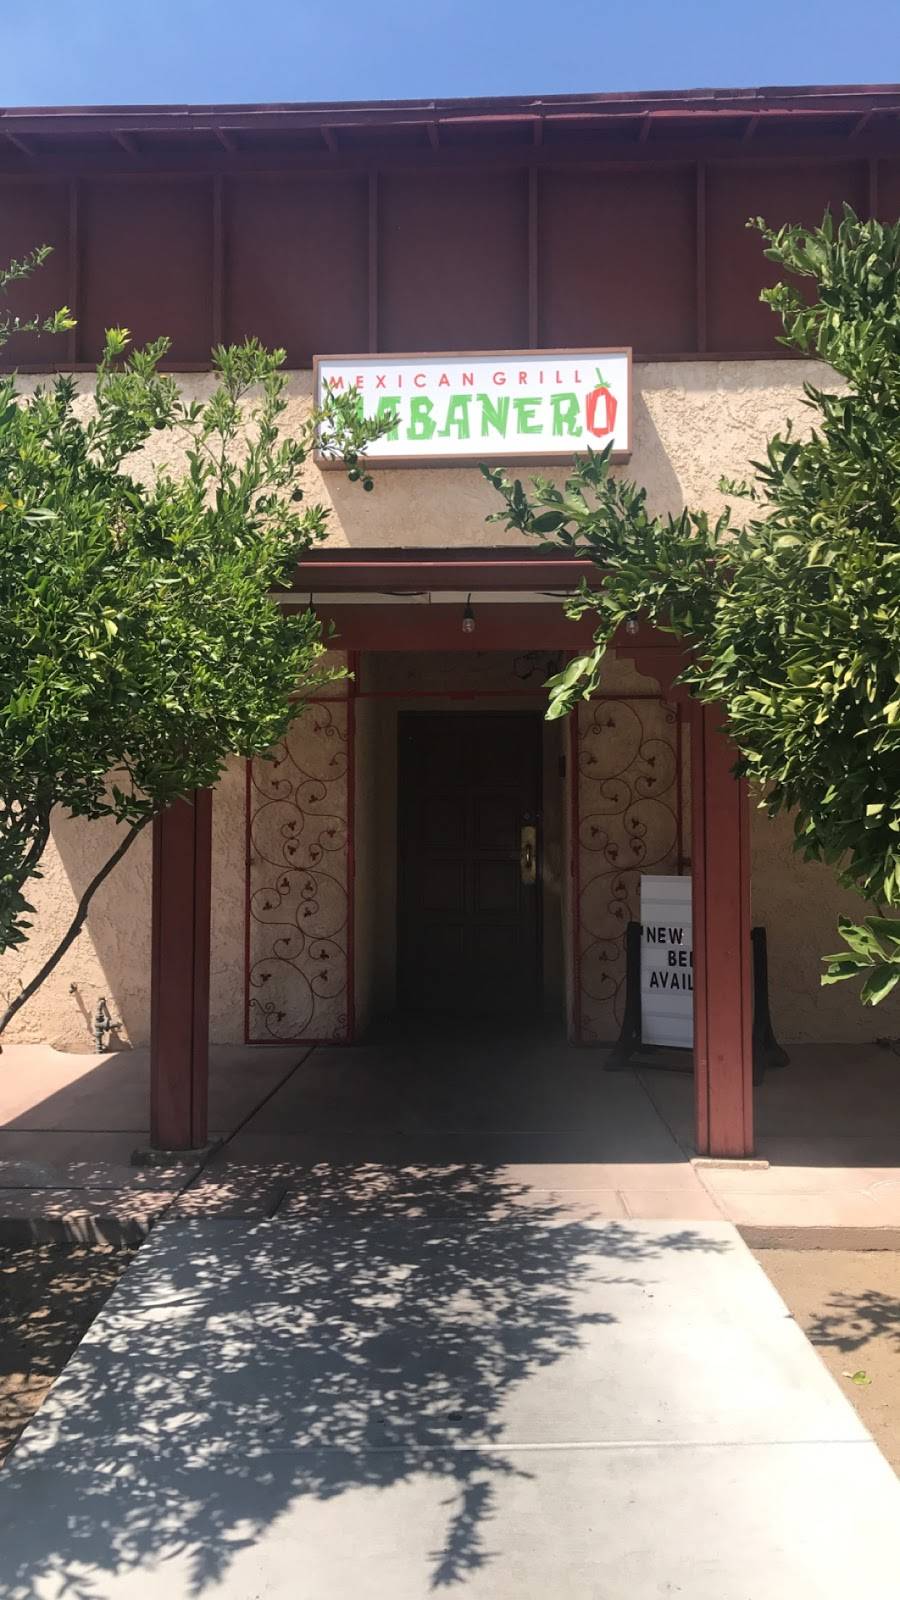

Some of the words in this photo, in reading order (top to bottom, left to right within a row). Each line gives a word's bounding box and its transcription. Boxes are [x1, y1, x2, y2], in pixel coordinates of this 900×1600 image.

[329, 372, 474, 389] MEXICAN
[493, 369, 582, 385] GRILL
[646, 926, 683, 944] NEW
